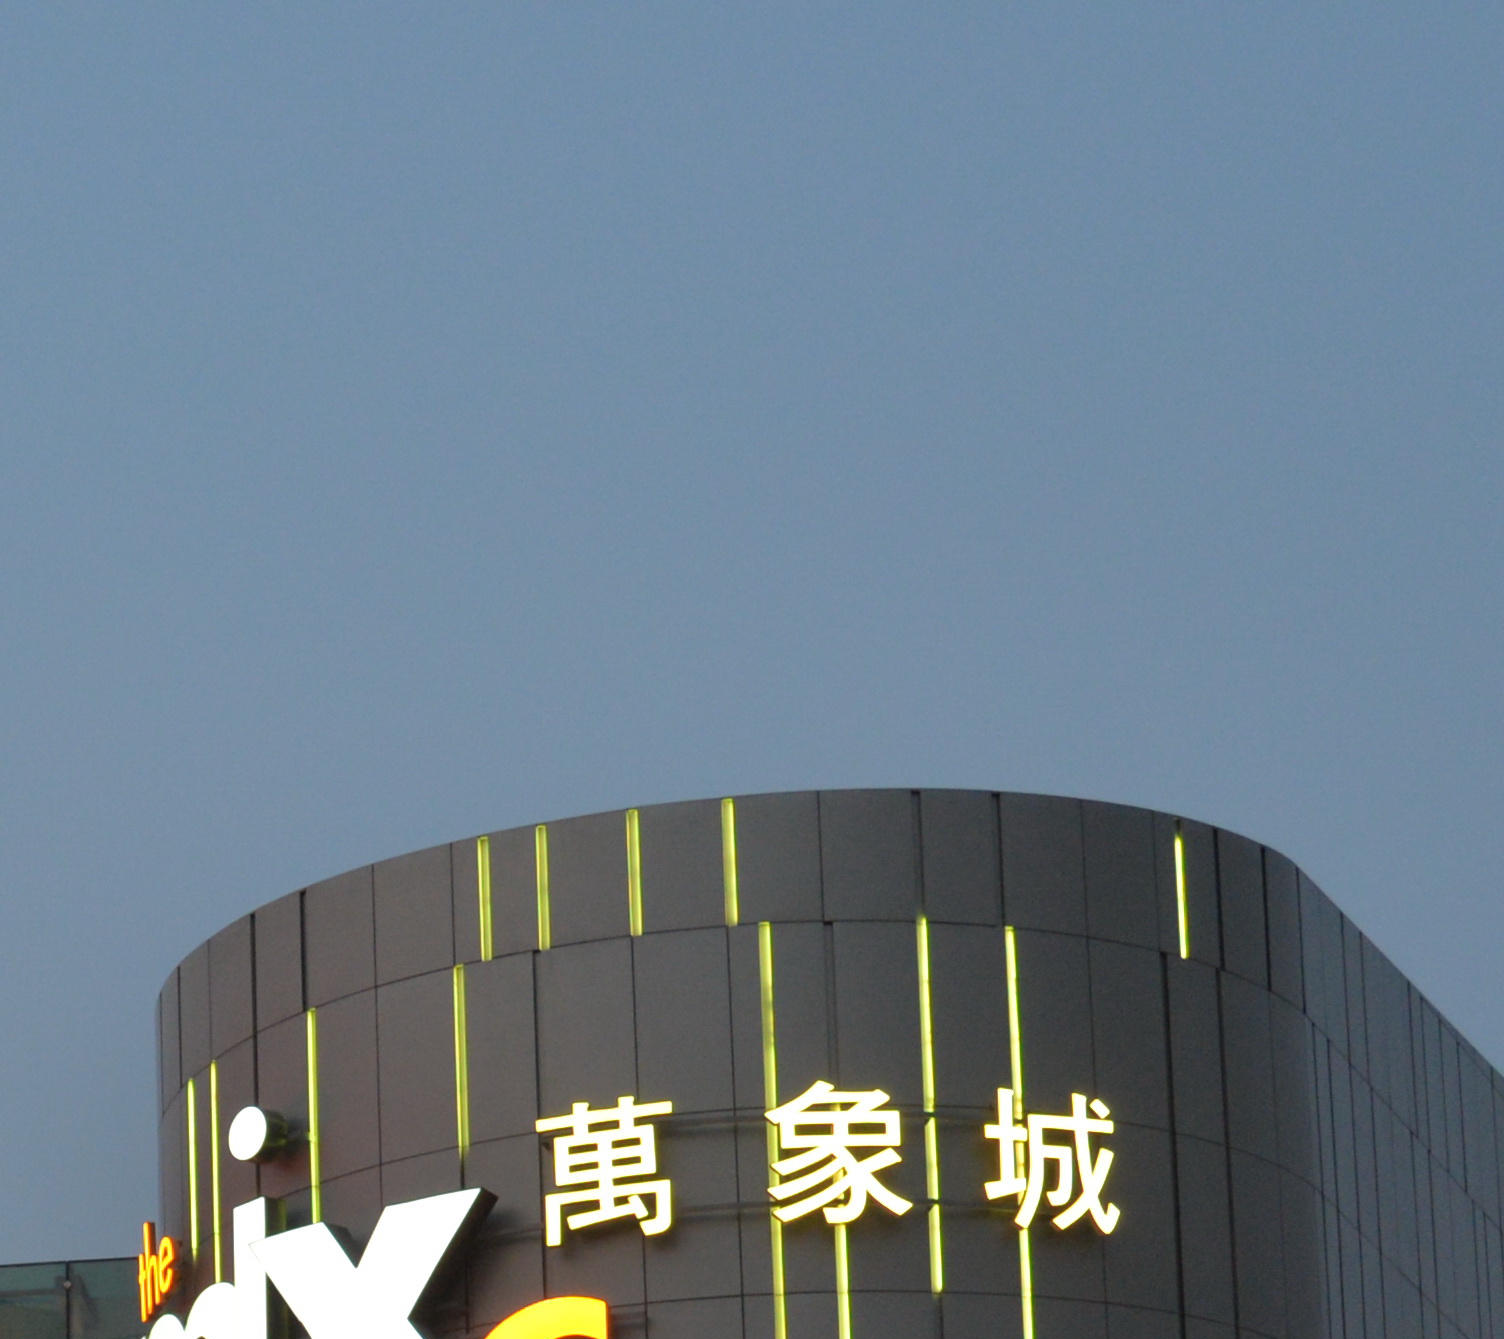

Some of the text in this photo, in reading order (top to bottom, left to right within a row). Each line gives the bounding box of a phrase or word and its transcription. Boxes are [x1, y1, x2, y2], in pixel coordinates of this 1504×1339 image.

[535, 1081, 1120, 1246] 萬象城
[138, 1222, 174, 1322] the
